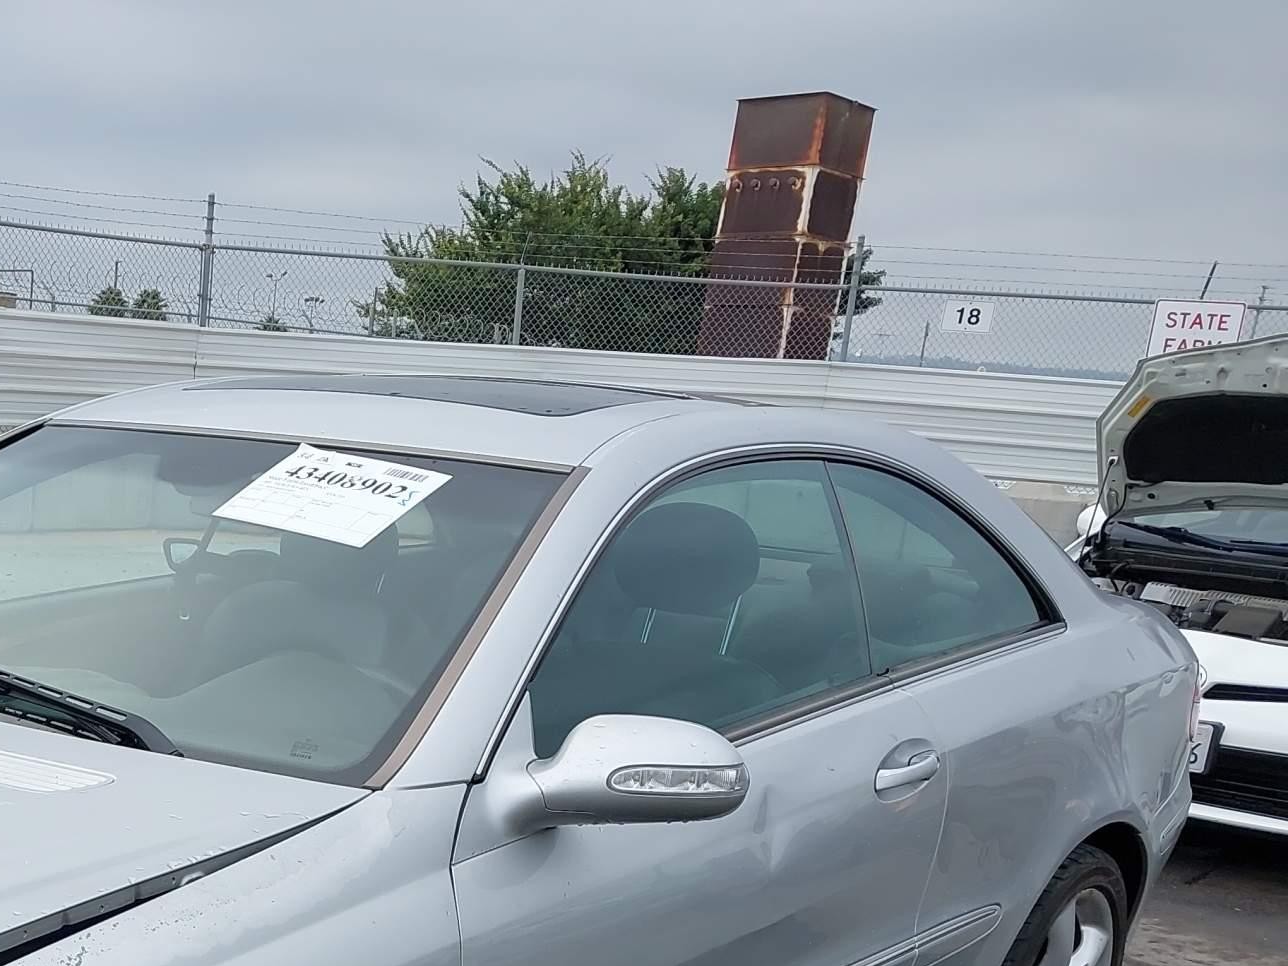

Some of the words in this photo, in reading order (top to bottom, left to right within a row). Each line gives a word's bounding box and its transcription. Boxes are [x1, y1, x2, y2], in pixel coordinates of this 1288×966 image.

[956, 307, 981, 325] 18
[1165, 311, 1231, 331] STATE
[284, 465, 408, 499] 43408902
